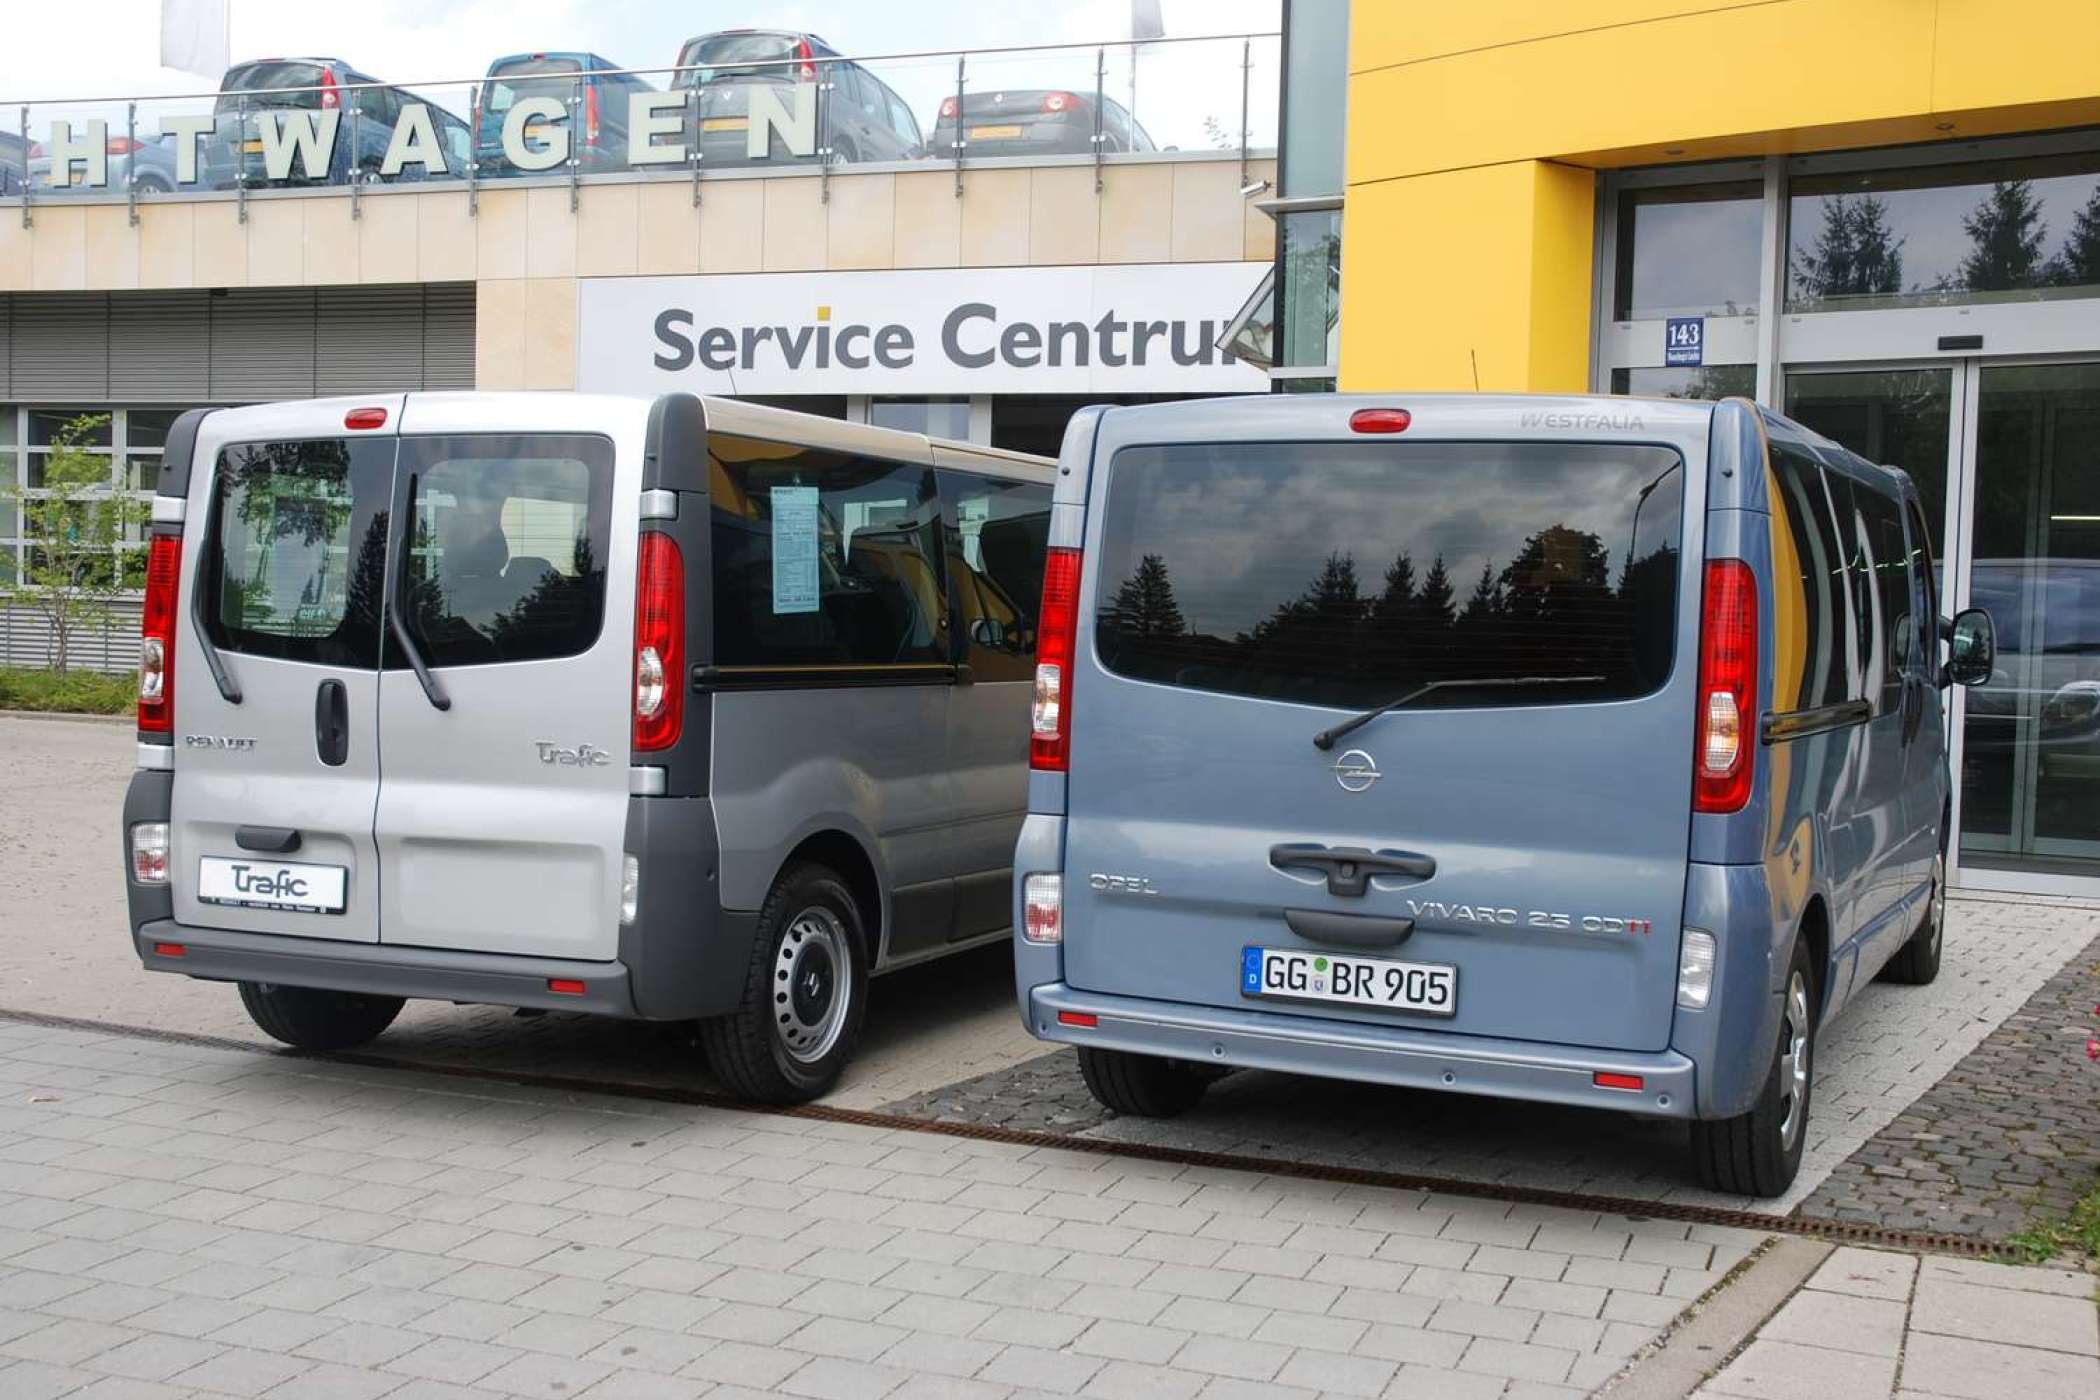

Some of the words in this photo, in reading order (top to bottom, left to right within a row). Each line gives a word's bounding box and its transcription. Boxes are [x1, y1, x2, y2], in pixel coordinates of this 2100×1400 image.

[653, 305, 913, 372] Service
[1669, 323, 1700, 346] 143
[1520, 413, 1645, 431] WESTFALIA
[535, 741, 611, 768] Trafic
[231, 865, 308, 898] Trafic
[1090, 873, 1159, 894] OPEL
[1265, 956, 1308, 991] GG
[1332, 962, 1375, 998] BR
[1385, 968, 1450, 1005] 905
